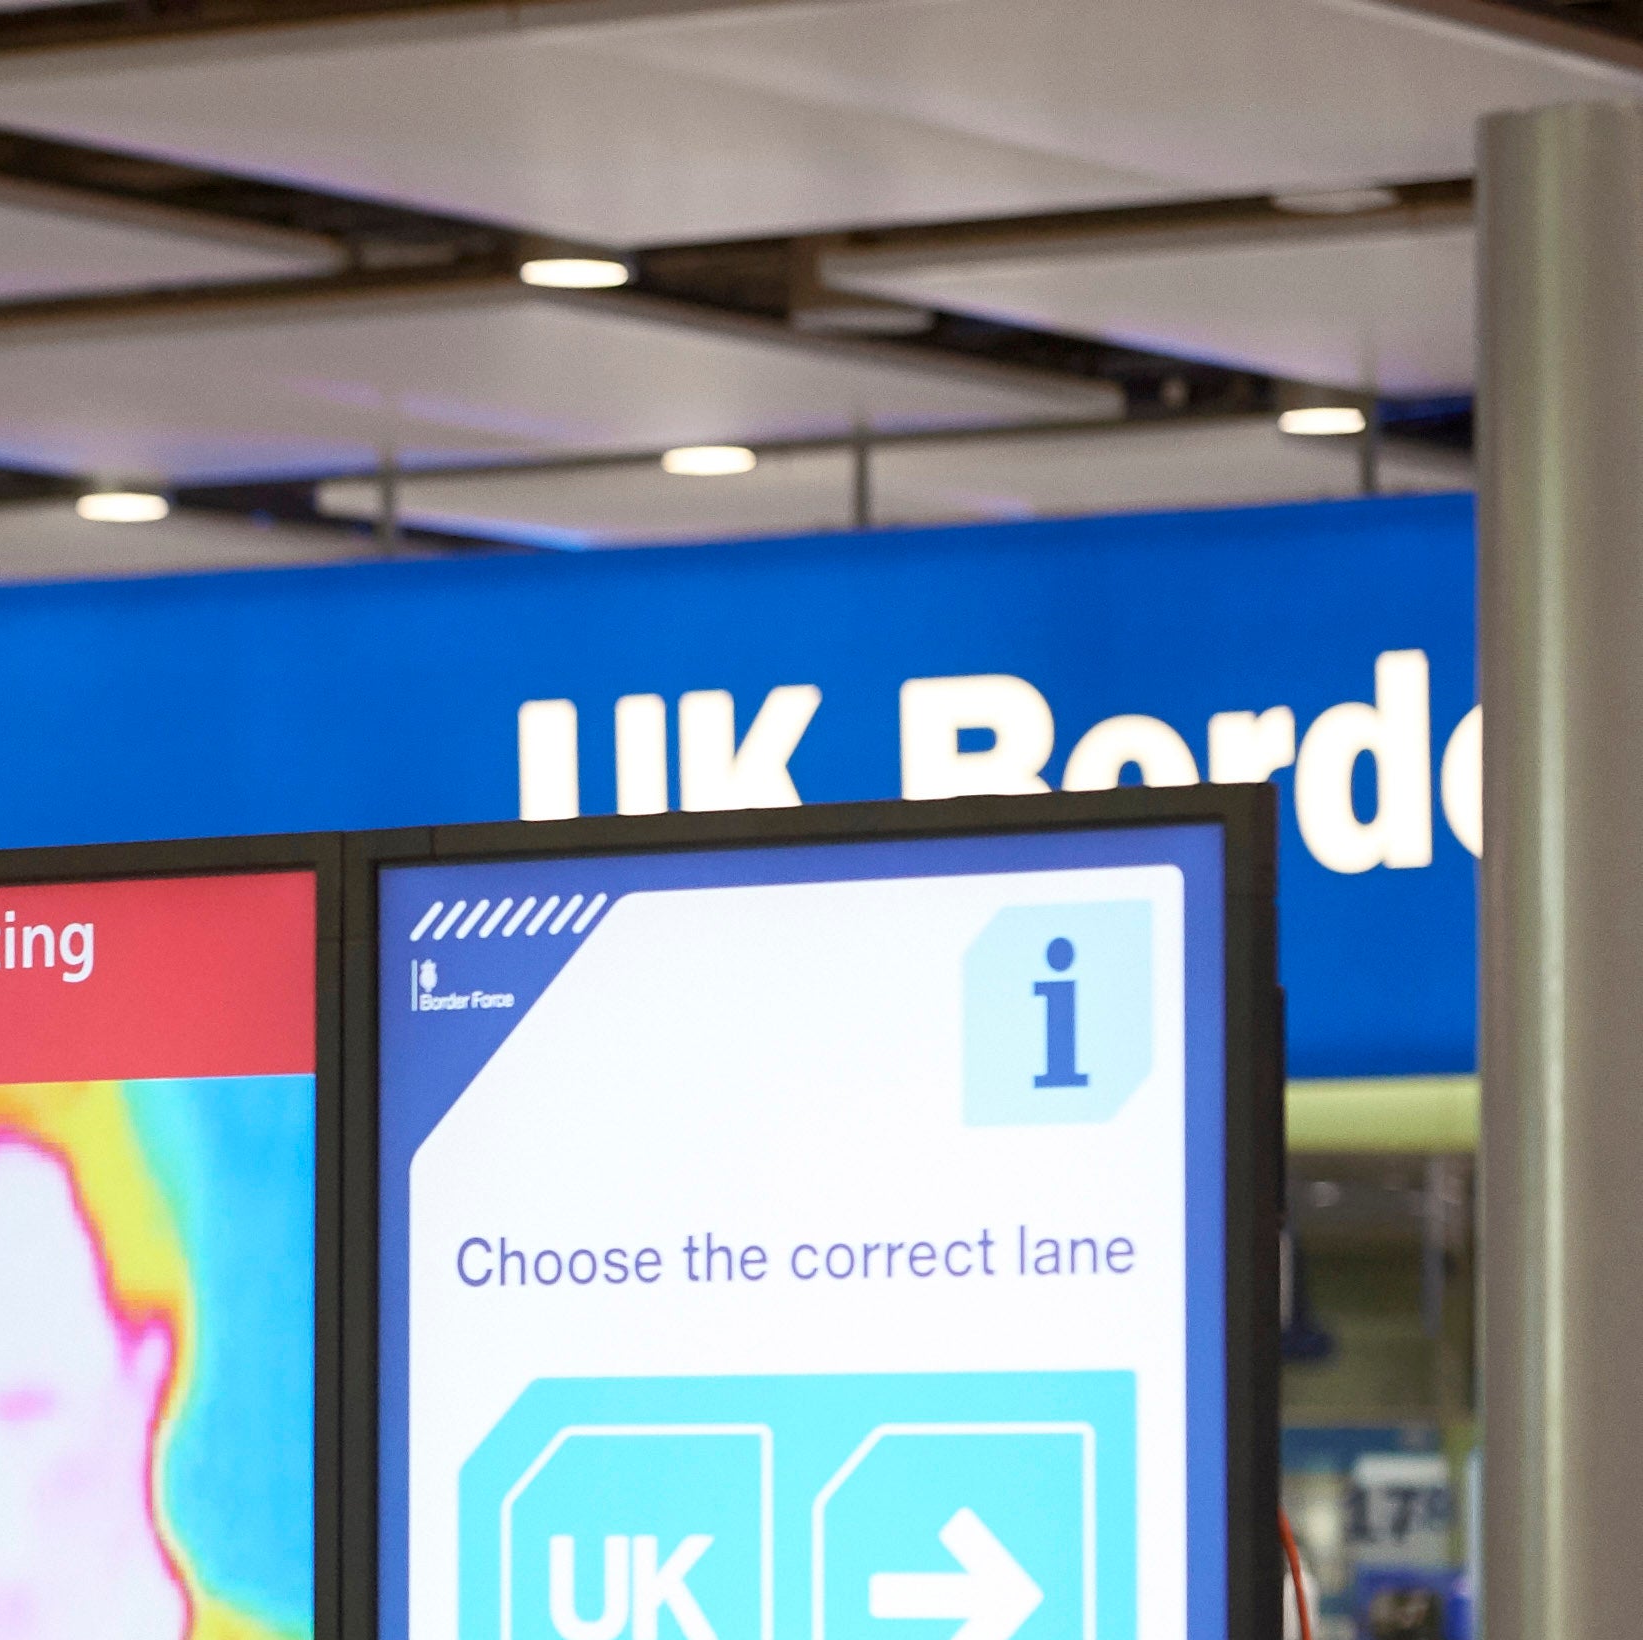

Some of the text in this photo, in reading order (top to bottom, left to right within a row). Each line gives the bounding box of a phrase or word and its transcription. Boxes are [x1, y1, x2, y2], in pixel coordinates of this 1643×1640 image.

[518, 684, 822, 822] UK
[419, 991, 514, 1011] Border Force
[457, 1225, 1135, 1287] Choose the correct lane
